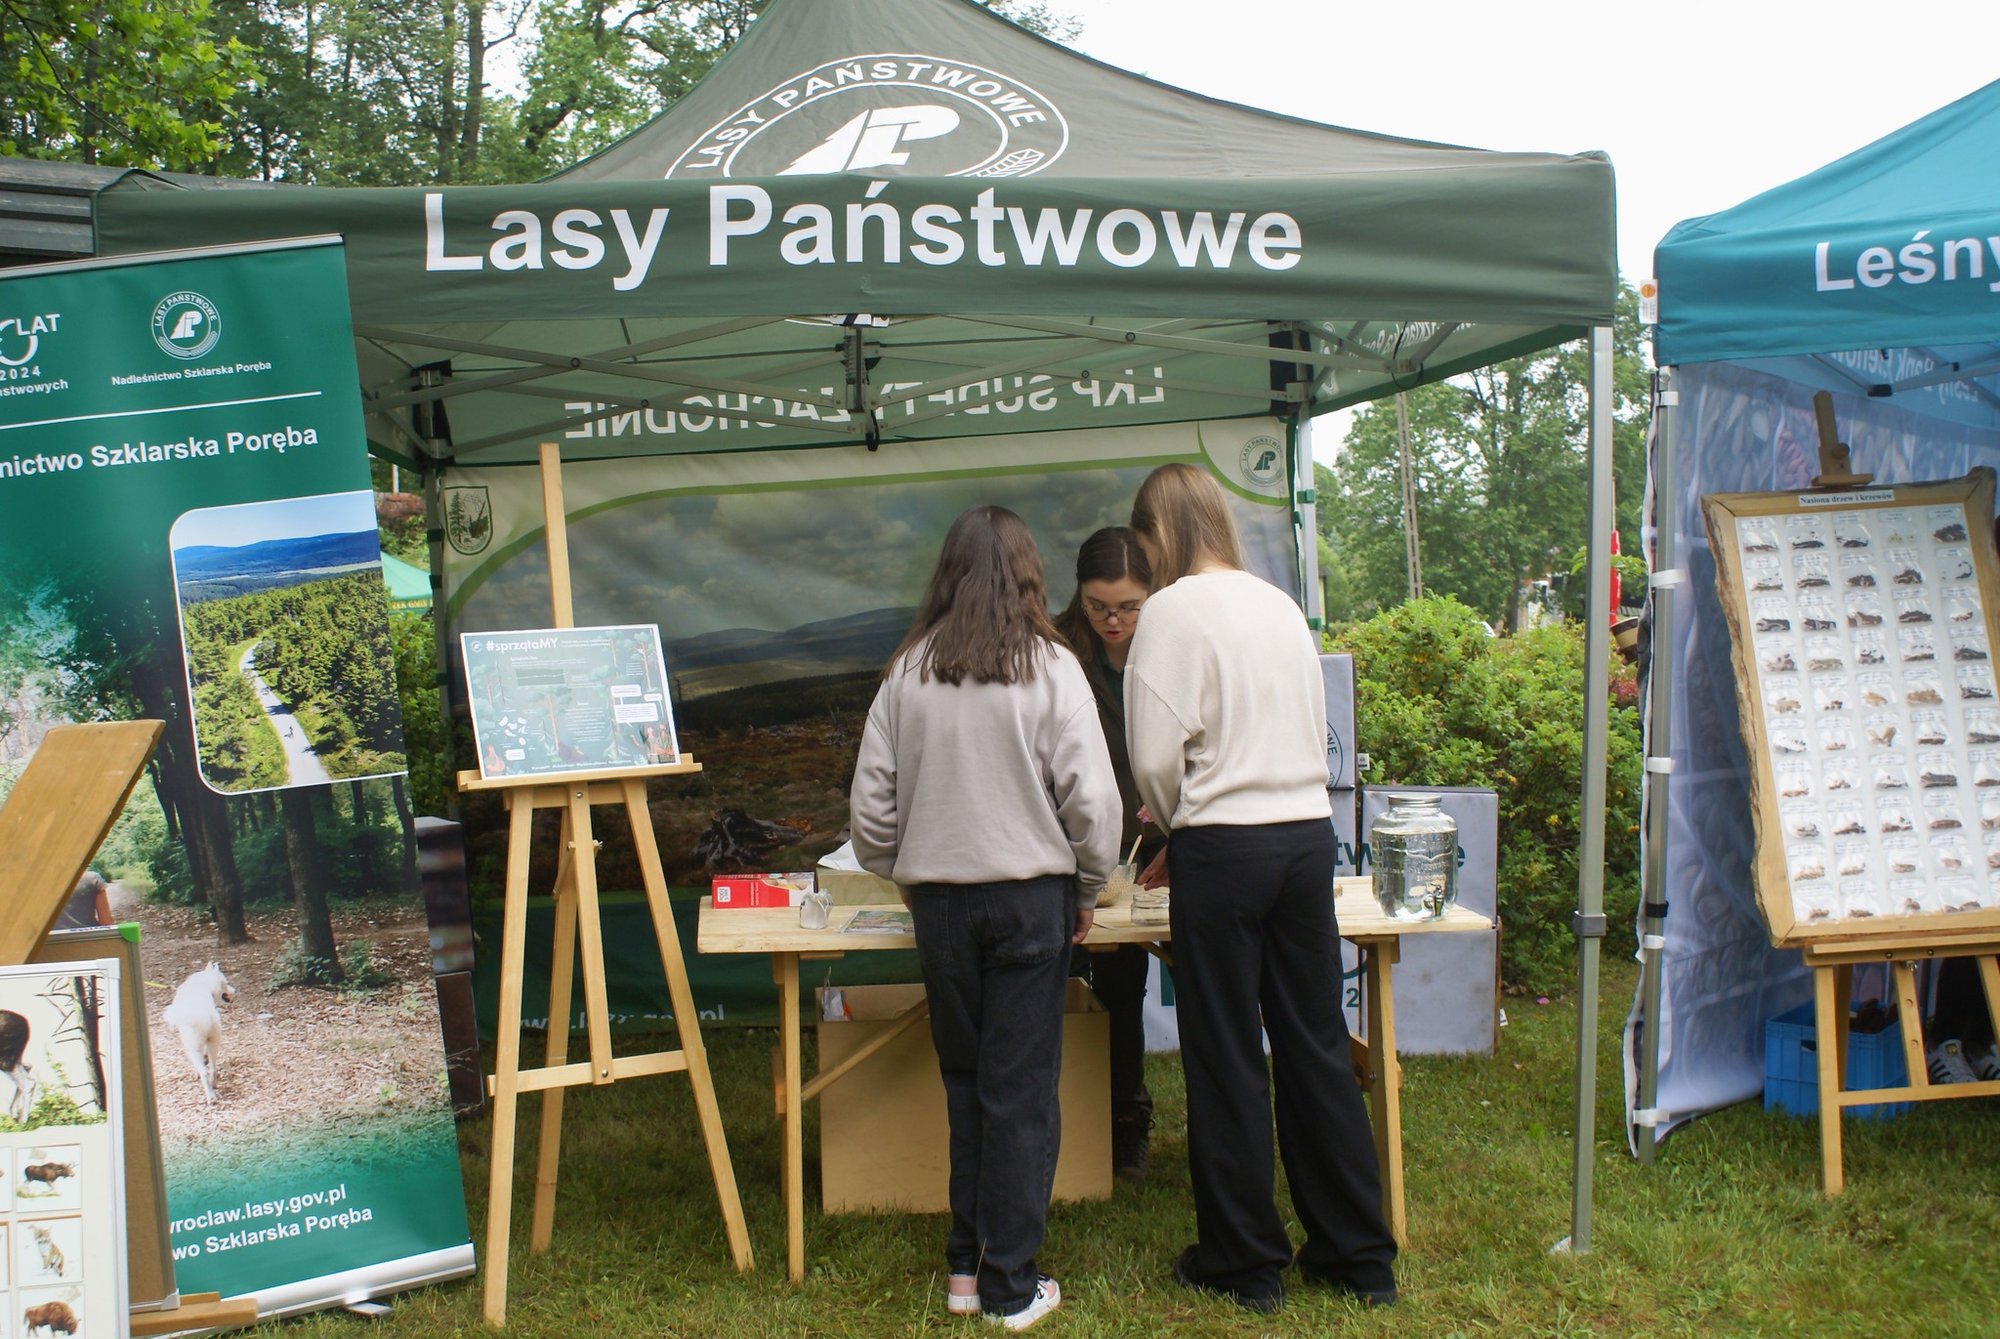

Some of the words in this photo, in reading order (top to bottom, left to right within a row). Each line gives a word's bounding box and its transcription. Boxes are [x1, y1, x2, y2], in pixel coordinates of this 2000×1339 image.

[686, 110, 766, 168] LASY
[772, 61, 1046, 128] PAŃSTWOWE
[425, 193, 670, 292] Lasy
[709, 180, 1302, 271] Państwowe
[16, 313, 60, 336] LAT
[155, 304, 168, 327] LASY
[167, 293, 217, 322] PAŃSTWOWE
[0, 379, 69, 397] stwowych
[112, 371, 182, 386] Nadleśnictwo
[184, 366, 233, 379] Szklarska
[236, 360, 272, 374] Poręba
[91, 436, 220, 468] Szklarska
[227, 425, 318, 453] Poręba
[205, 1222, 301, 1254] Szklarska
[305, 1207, 373, 1233] Poręba
